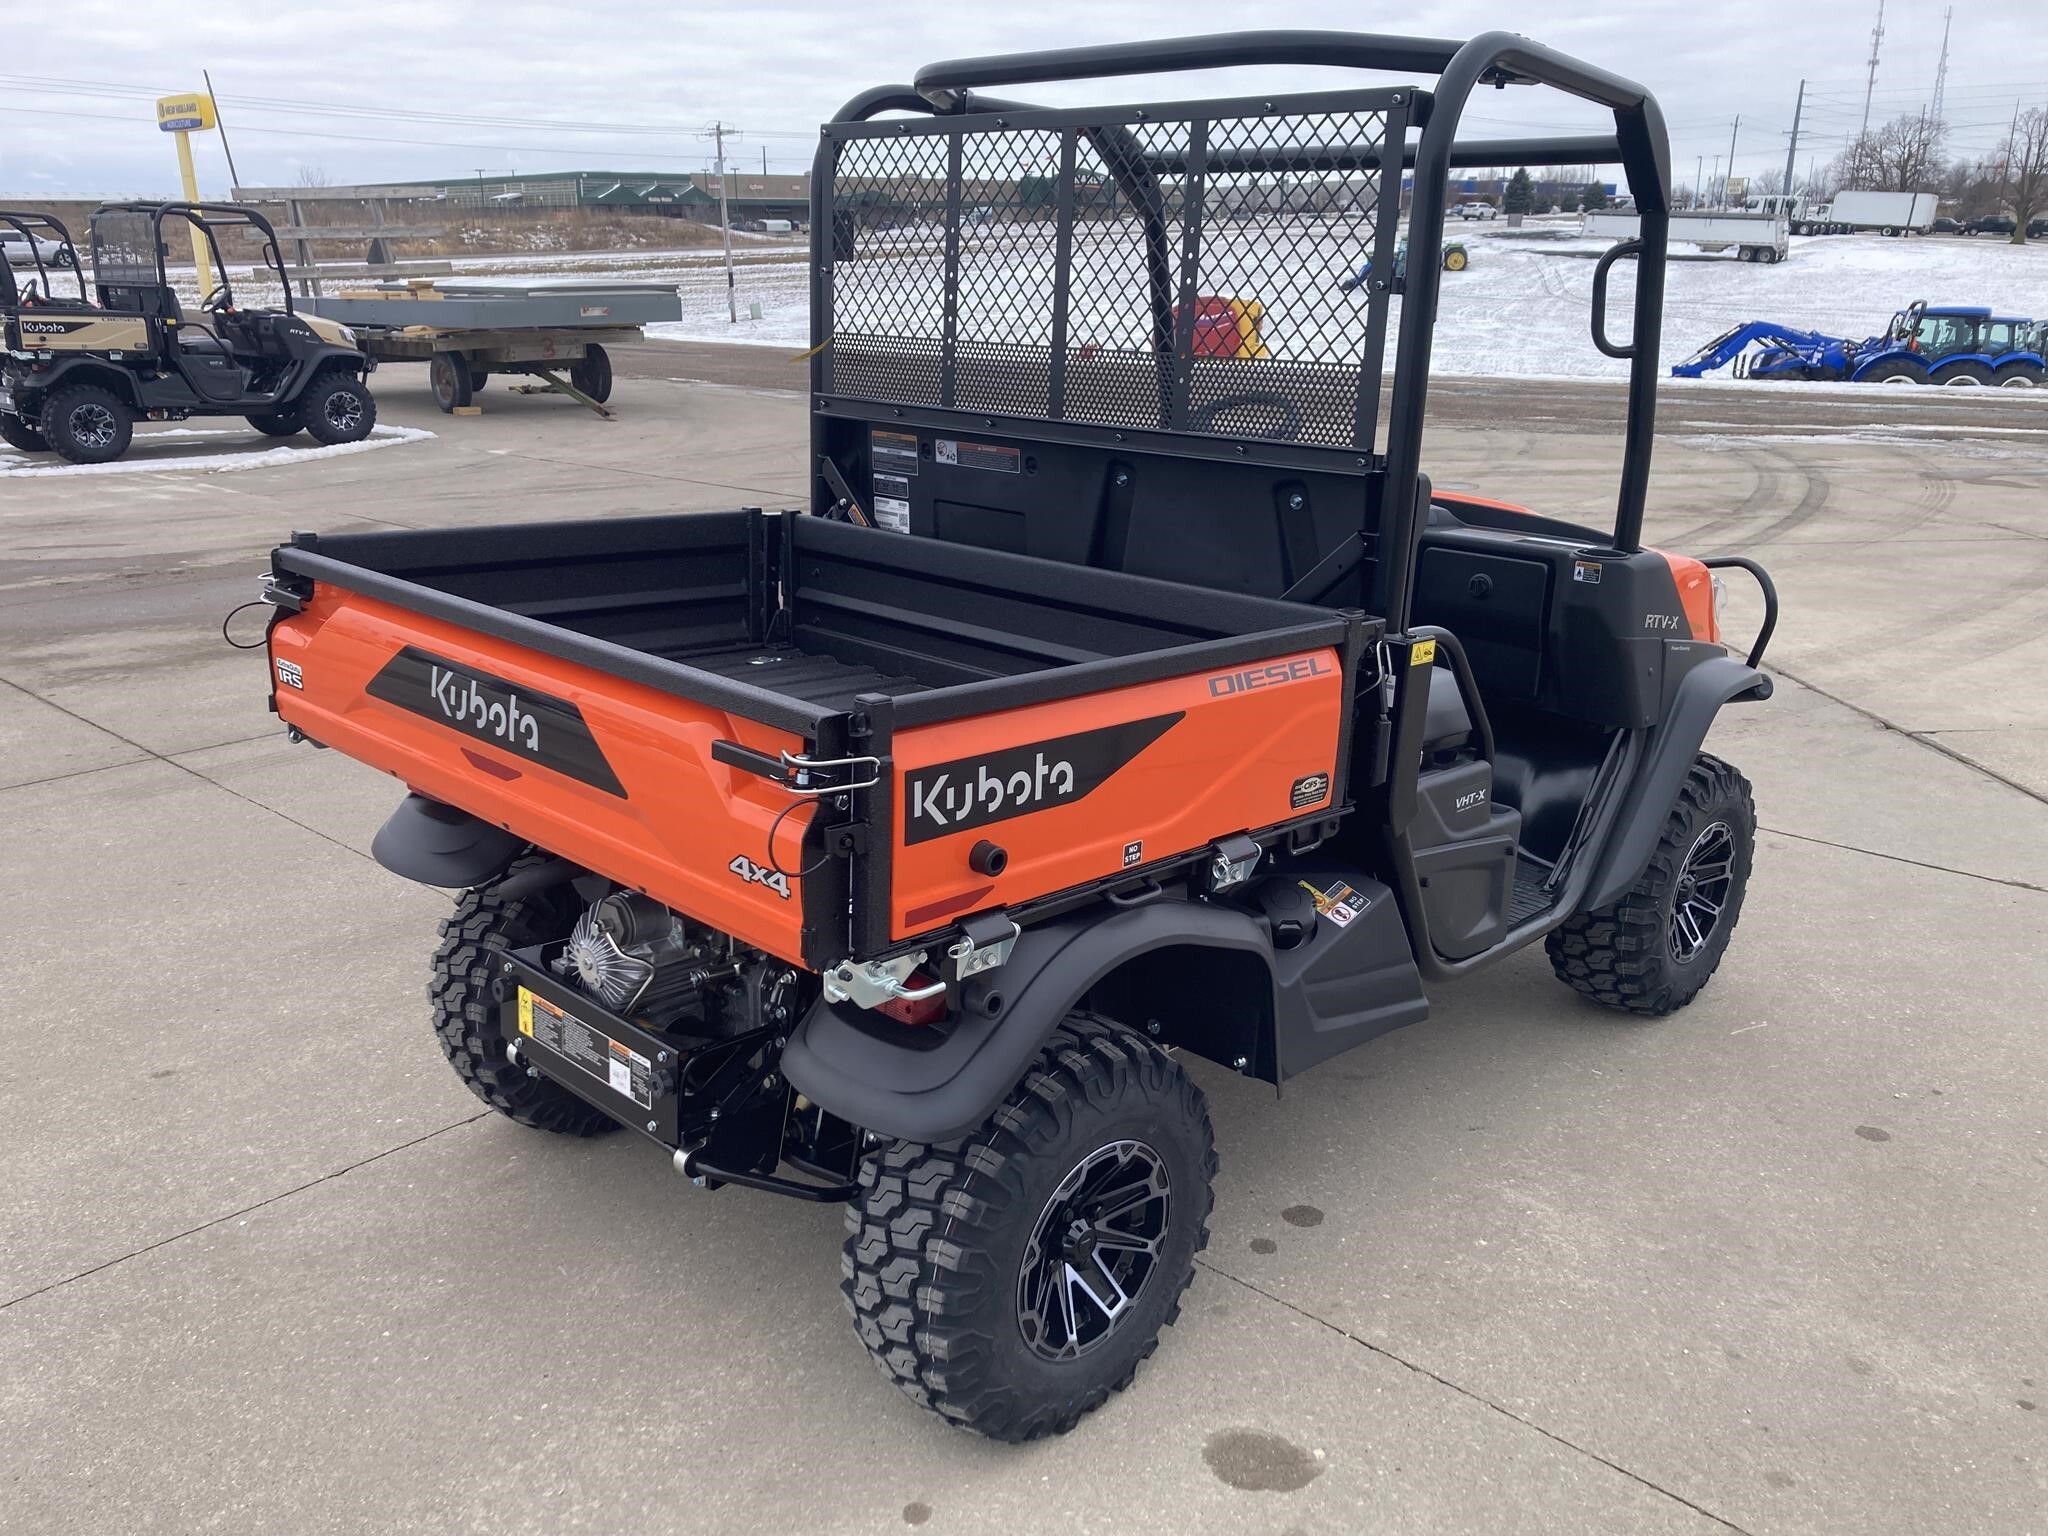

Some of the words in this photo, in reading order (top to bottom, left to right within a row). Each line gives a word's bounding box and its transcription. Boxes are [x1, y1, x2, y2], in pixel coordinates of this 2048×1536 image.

[23, 322, 65, 333] Kubota
[1645, 614, 1679, 630] RTV-X
[278, 668, 303, 689] IRS
[1208, 658, 1332, 697] DIESEL
[430, 665, 539, 752] Kubota
[913, 752, 1074, 826] Kubota
[1456, 788, 1486, 808] VHT-X
[1125, 852, 1141, 863] STEP
[1128, 845, 1138, 854] NO
[1348, 895, 1358, 904] NO
[1351, 897, 1364, 910] STEP
